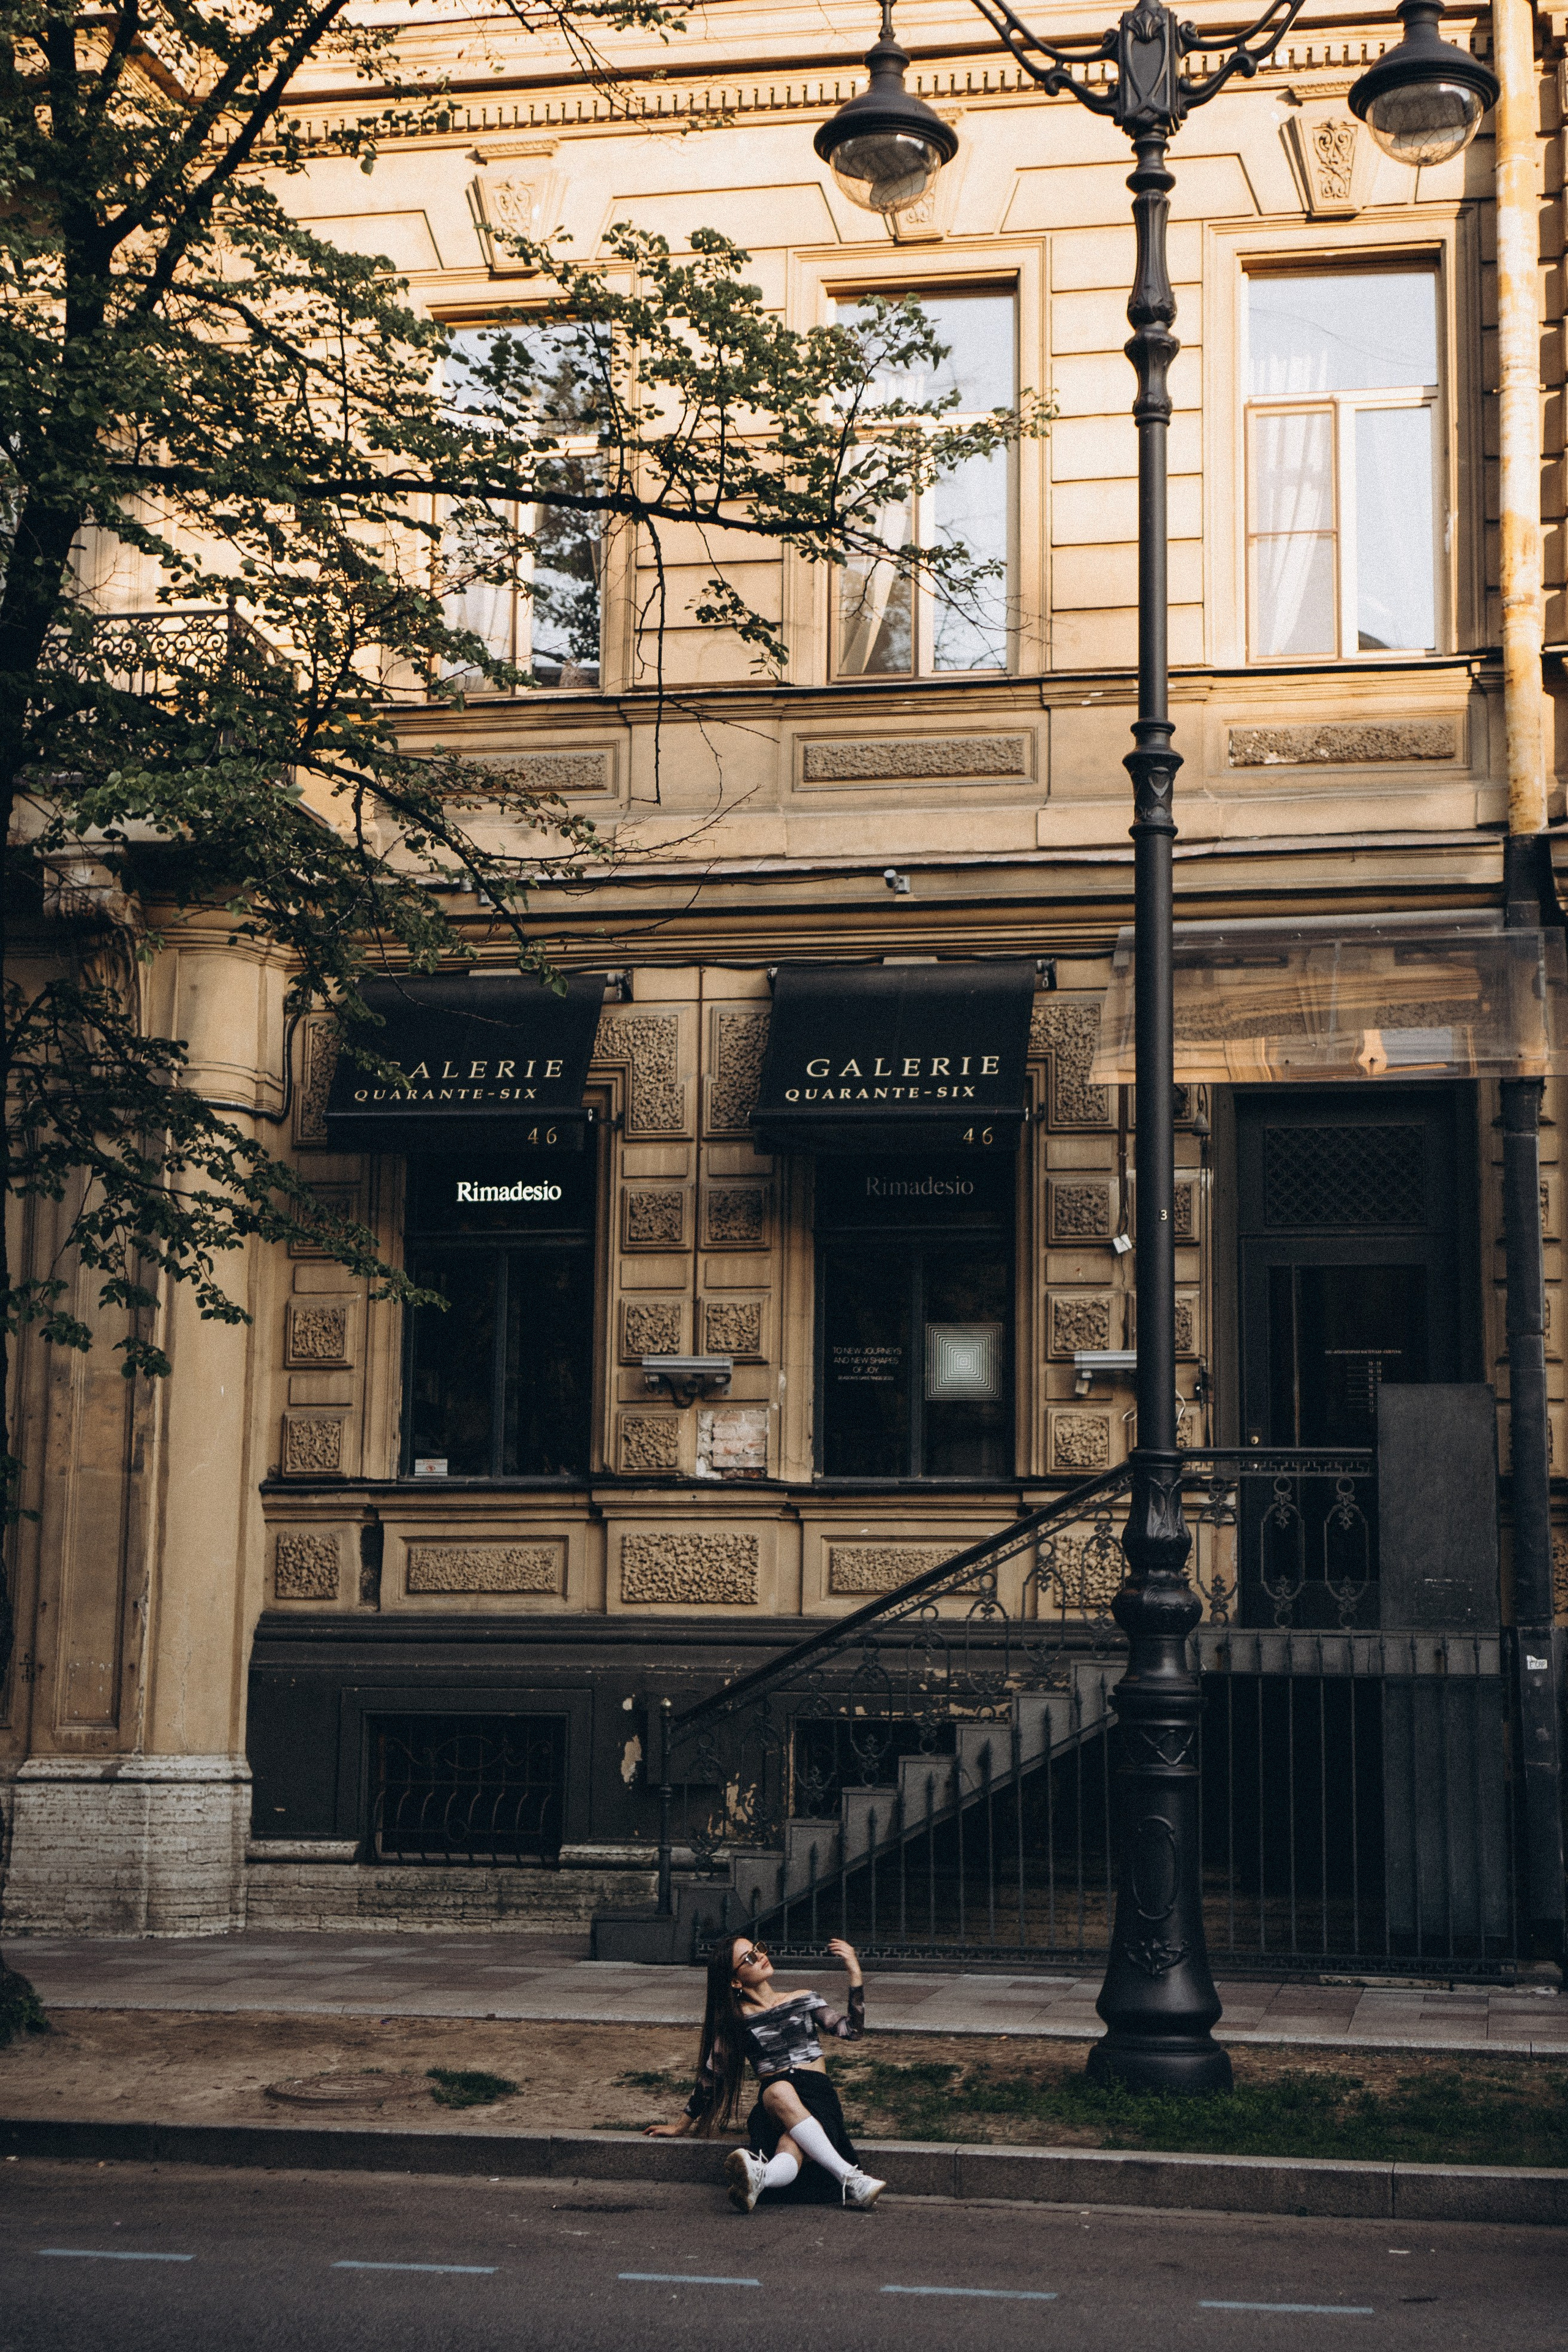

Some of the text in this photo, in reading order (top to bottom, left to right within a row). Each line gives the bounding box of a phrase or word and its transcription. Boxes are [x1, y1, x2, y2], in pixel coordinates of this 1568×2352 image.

[805, 1055, 1001, 1077] GALERIE
[353, 1088, 538, 1102] QUARANTE-SIX
[785, 1085, 976, 1102] QUARANTE-SIX
[527, 1126, 558, 1144] 46
[962, 1126, 994, 1145] 46
[456, 1180, 562, 1202] Rimadesio
[865, 1175, 974, 1196] Rimadesio
[1161, 1209, 1167, 1220] 3
